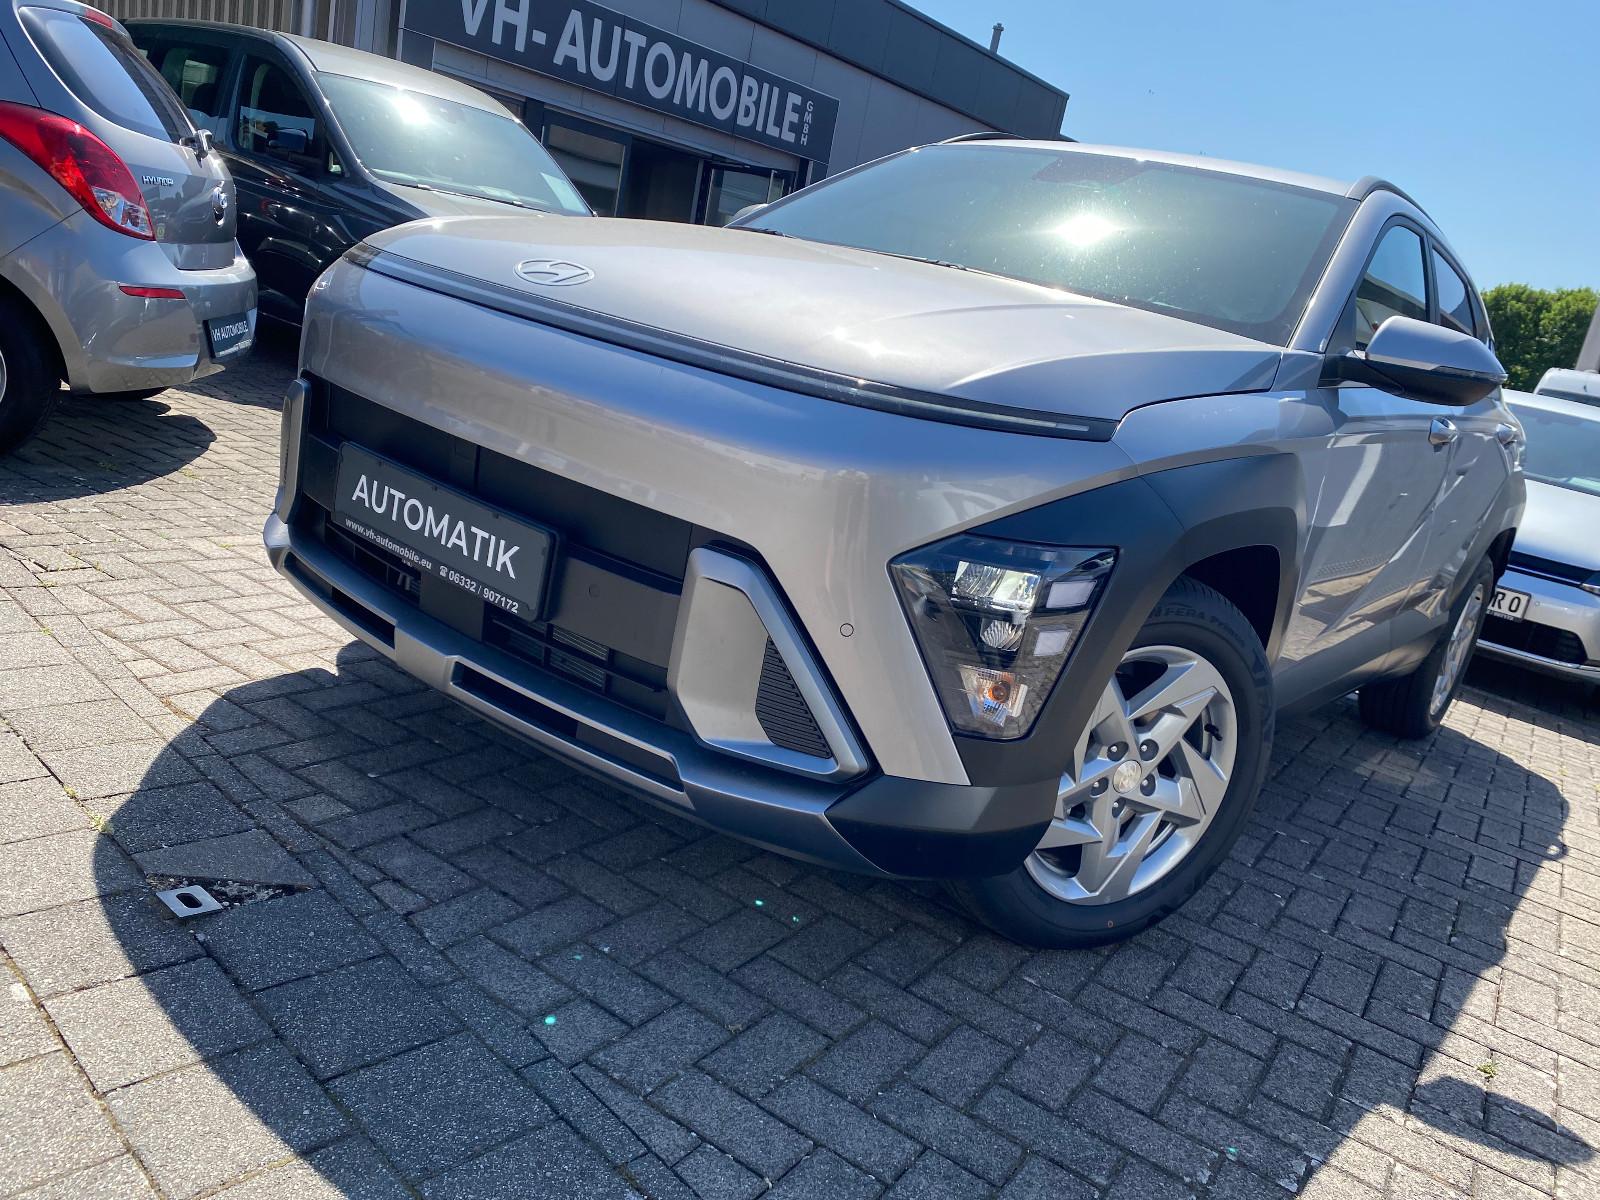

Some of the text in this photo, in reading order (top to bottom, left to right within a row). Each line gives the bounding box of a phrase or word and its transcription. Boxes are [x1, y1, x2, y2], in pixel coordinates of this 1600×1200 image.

[552, 9, 802, 143] AUTOMOBILE
[800, 100, 814, 146] GMBH
[142, 175, 174, 187] HYUNDAI
[221, 320, 249, 340] AUTOMOBILE
[351, 474, 520, 580] AUTOMATIK
[345, 518, 432, 570] www.vh-automobile.eu
[448, 570, 476, 593] 06332
[483, 587, 519, 614] 907172
